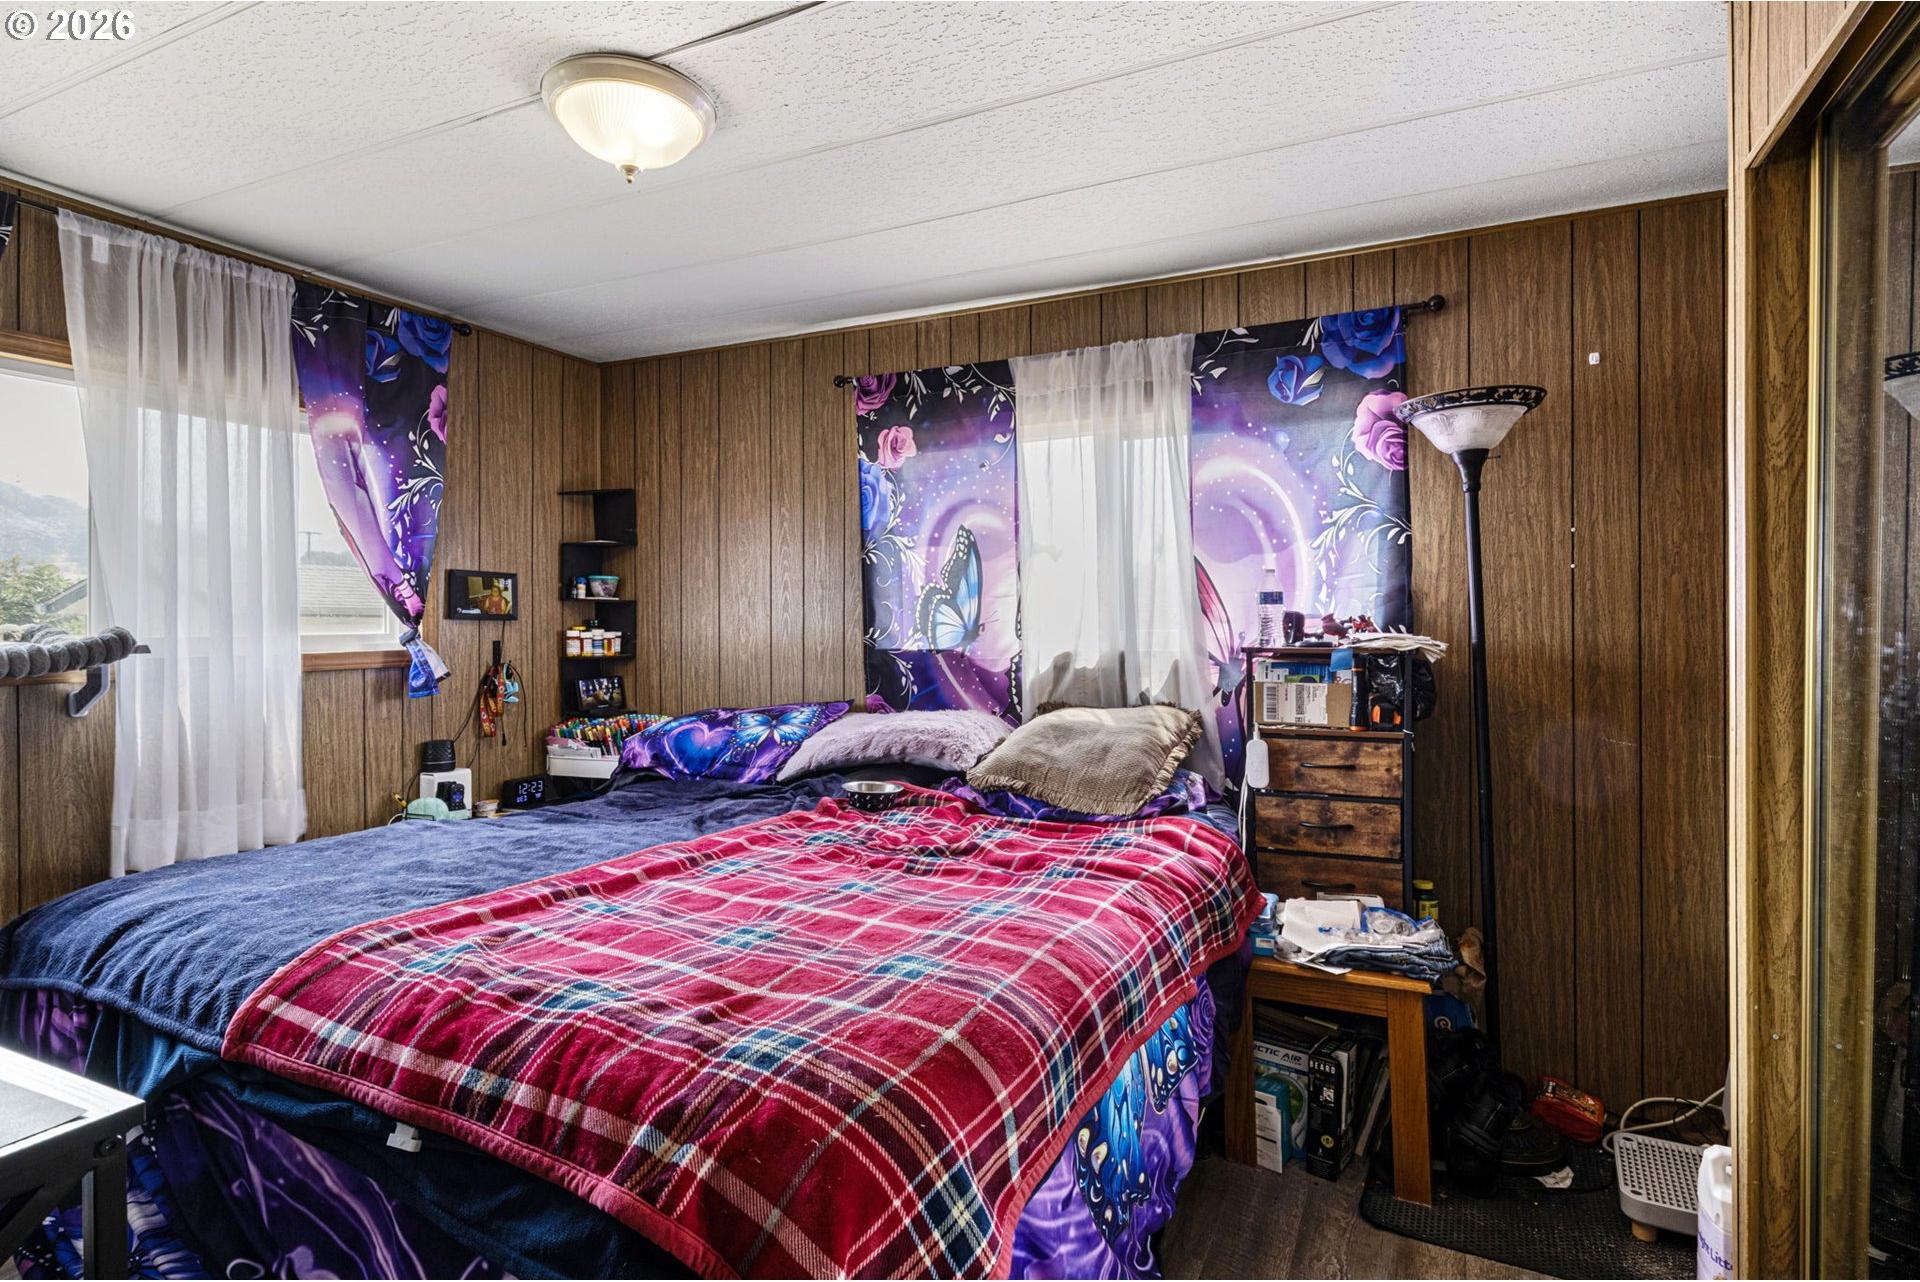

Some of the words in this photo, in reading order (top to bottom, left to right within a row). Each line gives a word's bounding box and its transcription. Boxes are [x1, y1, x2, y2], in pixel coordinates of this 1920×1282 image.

[518, 781, 543, 794] 12:23
[1280, 1053, 1302, 1062] AIR
[1309, 1060, 1336, 1074] BEARD
[1710, 1247, 1733, 1271] Litt
